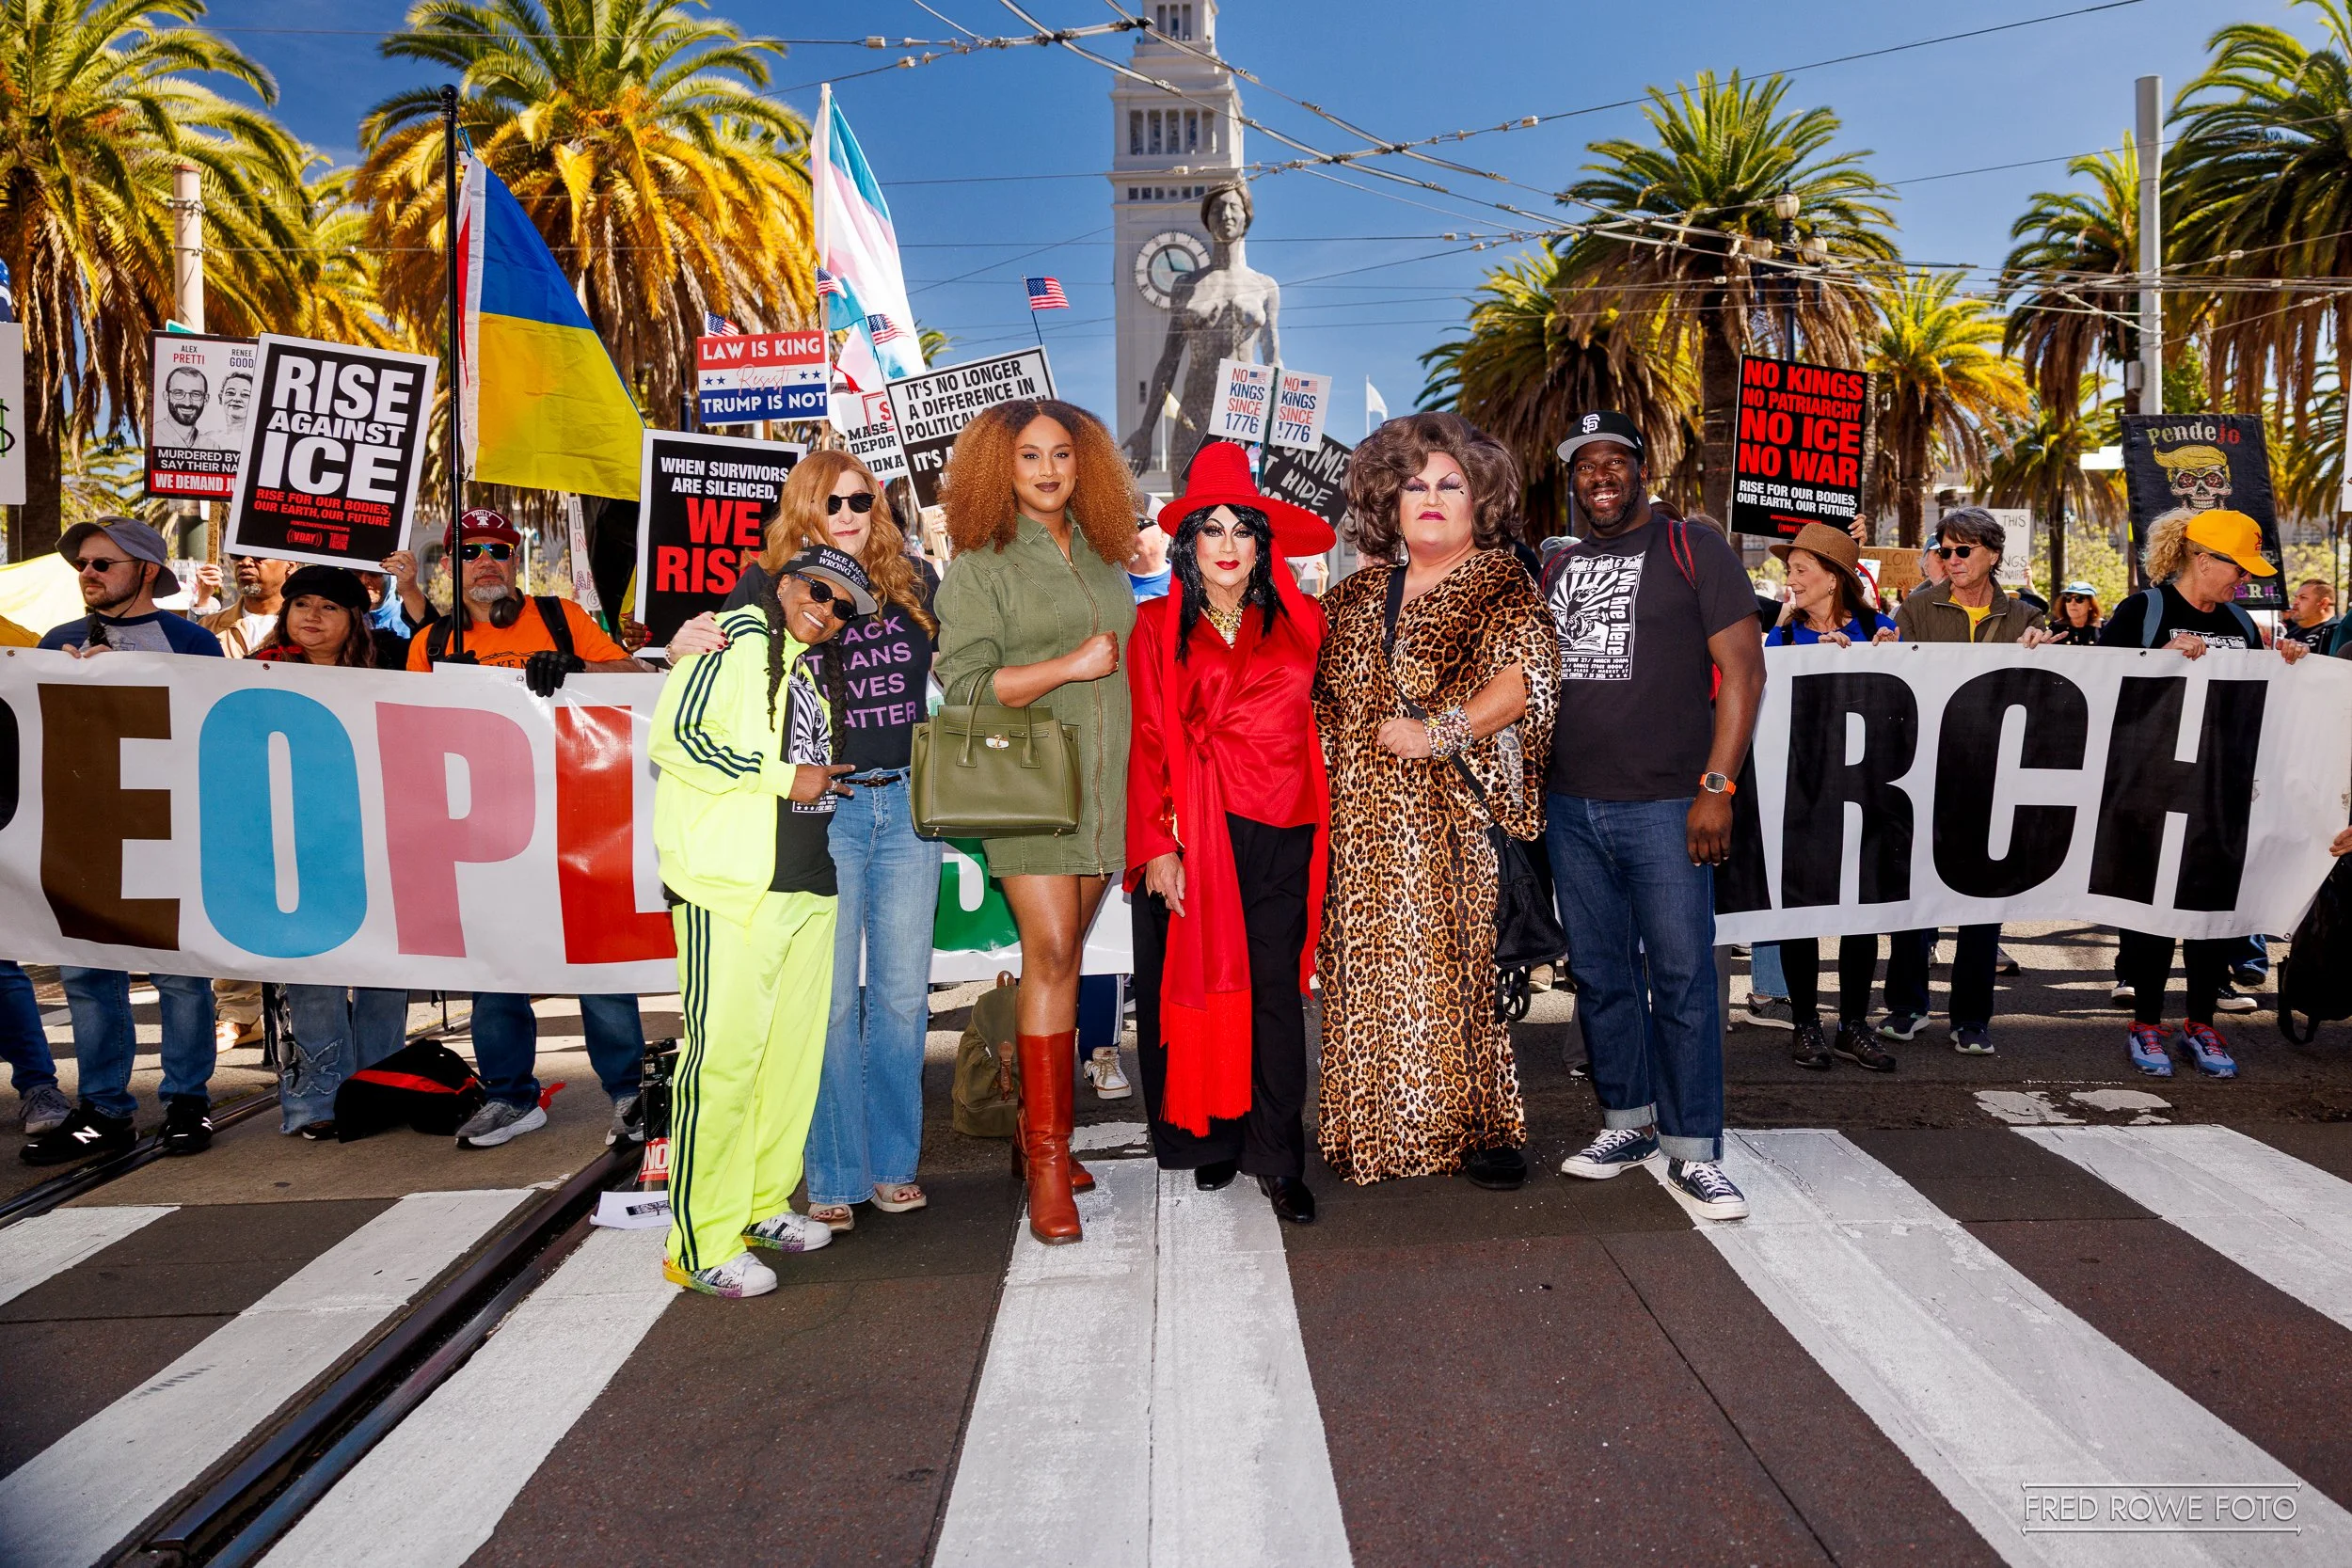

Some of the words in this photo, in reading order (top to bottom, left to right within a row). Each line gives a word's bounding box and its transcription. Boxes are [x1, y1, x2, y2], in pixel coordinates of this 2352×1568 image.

[173, 353, 205, 365] PRETTI
[231, 349, 253, 357] RENEE
[703, 341, 744, 360] LAW
[752, 341, 769, 357] IS
[774, 337, 820, 356] KING
[230, 357, 254, 369] GOOD
[905, 380, 932, 401] IT'S
[936, 373, 959, 393] NO
[961, 359, 1024, 388] LONGER
[1232, 368, 1248, 383] NO
[1283, 376, 1300, 391] NO
[1743, 358, 1779, 388] NO
[1787, 365, 1864, 401] KINGS
[272, 354, 414, 425] RISE
[909, 404, 919, 421] A
[923, 383, 1013, 418] DIFFERENCE
[1017, 376, 1036, 396] IN
[1230, 382, 1264, 401] KINGS
[1280, 390, 1317, 410] KINGS
[702, 395, 761, 413] TRUMP
[768, 394, 783, 410] IS
[788, 391, 826, 409] NOT
[1227, 397, 1263, 417] SINCE
[1741, 387, 1765, 407] NO
[1768, 390, 1863, 421] PATRIARCHY
[1225, 412, 1260, 435] 1776
[1279, 405, 1314, 425] SINCE
[1581, 414, 1600, 434] SF
[266, 409, 405, 446] AGAINST
[848, 421, 888, 441] MASS
[1278, 420, 1311, 443] 1776
[1740, 407, 1793, 445] NO
[1802, 416, 1861, 455] ICE
[158, 449, 222, 462] MURDERED
[224, 452, 241, 463] BY
[850, 435, 898, 455] DEPOR
[160, 459, 184, 470] SAY
[186, 460, 219, 472] THEIR
[257, 431, 403, 504] ICE
[660, 456, 705, 476] WHEN
[708, 461, 789, 483] SURVIVORS
[913, 449, 943, 471] IT'S
[1739, 442, 1781, 477] NO
[1788, 449, 1858, 488] WAR
[155, 473, 173, 488] WE
[176, 475, 224, 492] DEMAND
[671, 477, 702, 494] ARE
[706, 480, 778, 502] SILENCED,
[1280, 468, 1334, 507] HIDE
[1739, 479, 1765, 494] RISE
[1766, 483, 1788, 498] FOR
[1790, 486, 1813, 501] OUR
[1815, 489, 1858, 508] BODIES,
[254, 500, 278, 513] OUR
[280, 503, 319, 518] EARTH,
[321, 509, 344, 521] OUR
[347, 512, 390, 527] FUTURE
[256, 488, 285, 501] RISE
[288, 492, 312, 505] FOR
[315, 496, 342, 509] OUR
[344, 499, 391, 516] BODIES,
[1737, 492, 1757, 505] OUR
[1759, 495, 1793, 511] EARTH,
[1795, 499, 1817, 513] OUR
[1818, 502, 1856, 517] FUTURE
[686, 497, 761, 546] WE
[2002, 515, 2026, 528] THIS
[818, 556, 851, 576] WRONG
[820, 548, 848, 565] MAKE
[1614, 570, 1638, 594] We
[1610, 595, 1631, 620] Are
[842, 616, 906, 646] ACK
[1607, 623, 1630, 656] Here
[806, 641, 912, 675] TANS
[822, 673, 905, 702] VES
[844, 701, 916, 730] ATTER
